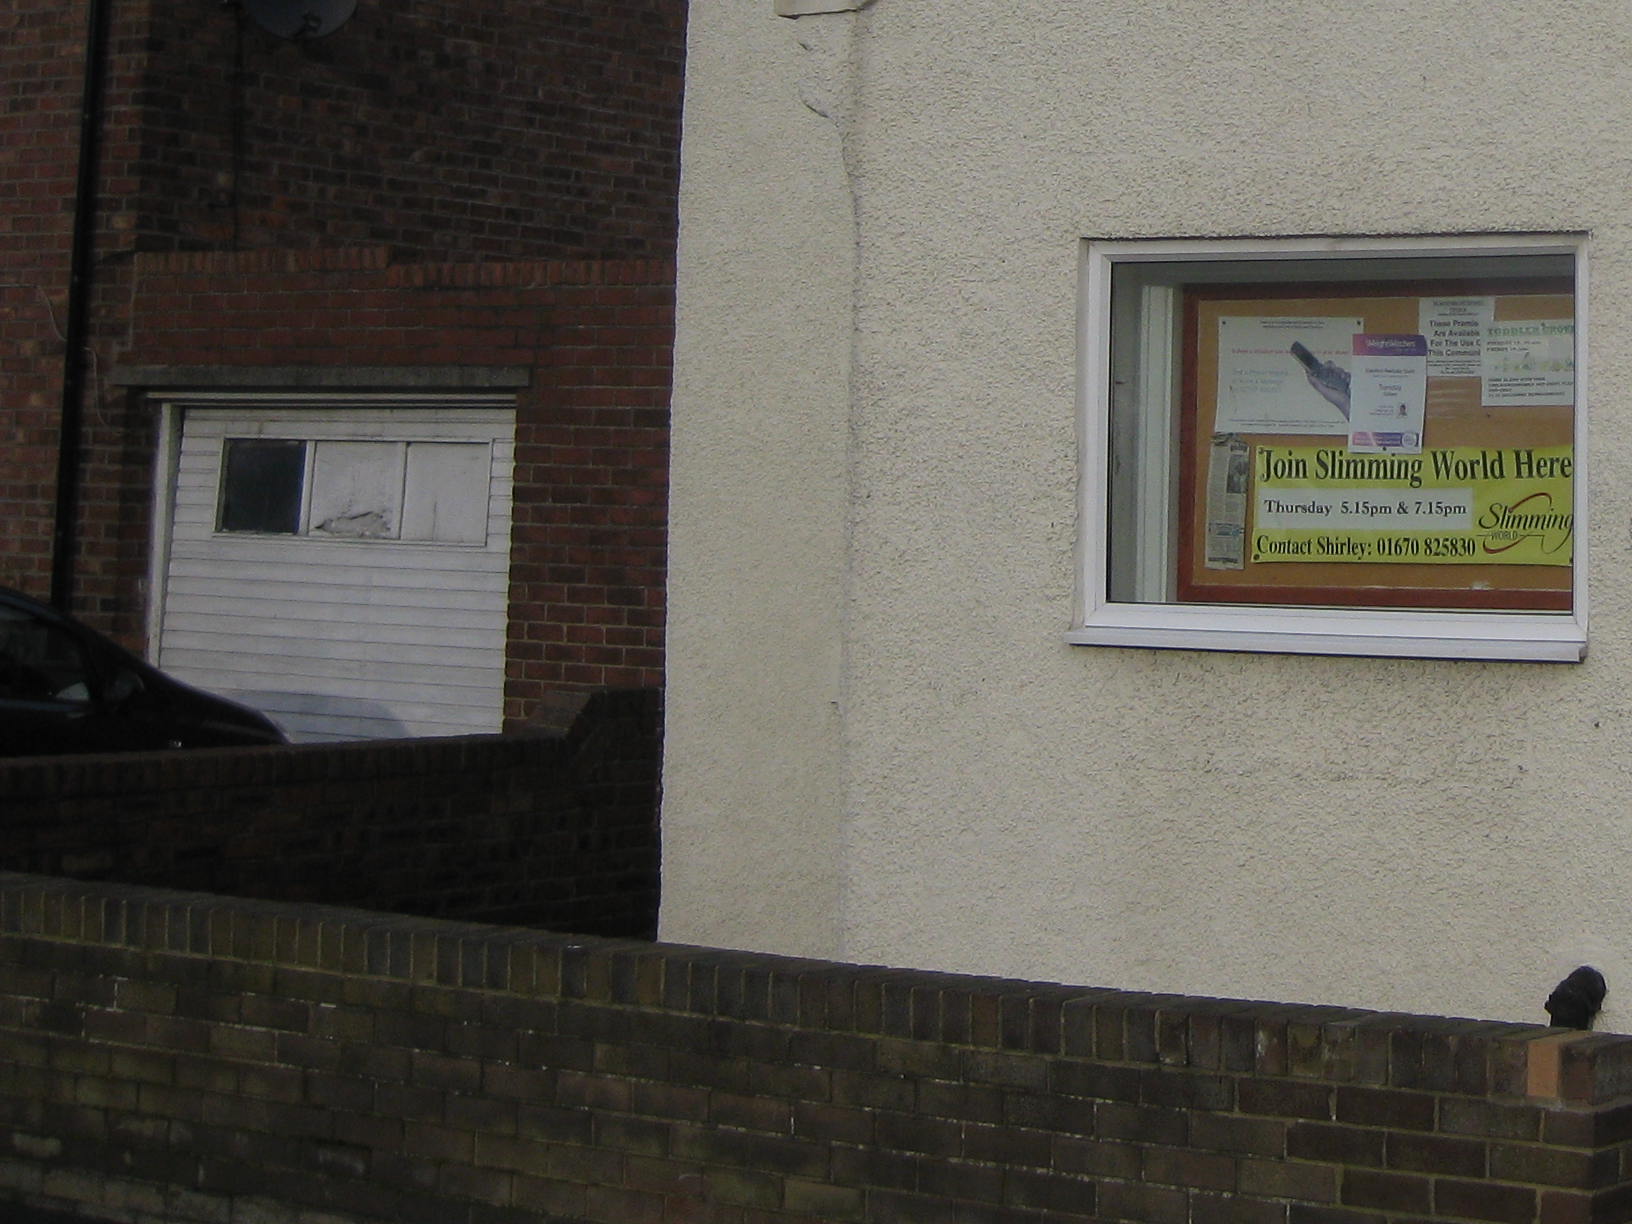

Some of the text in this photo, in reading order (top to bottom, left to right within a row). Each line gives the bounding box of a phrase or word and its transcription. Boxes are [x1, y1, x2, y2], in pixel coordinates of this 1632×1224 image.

[1261, 447, 1572, 488] Join Slimming World Here
[1264, 499, 1467, 517] Thursday 5.15pm & 7.15pm
[1478, 502, 1574, 553] Slimming
[1491, 530, 1519, 541] WORLD
[1256, 534, 1476, 559] Contact Shirley: 01670 825830
